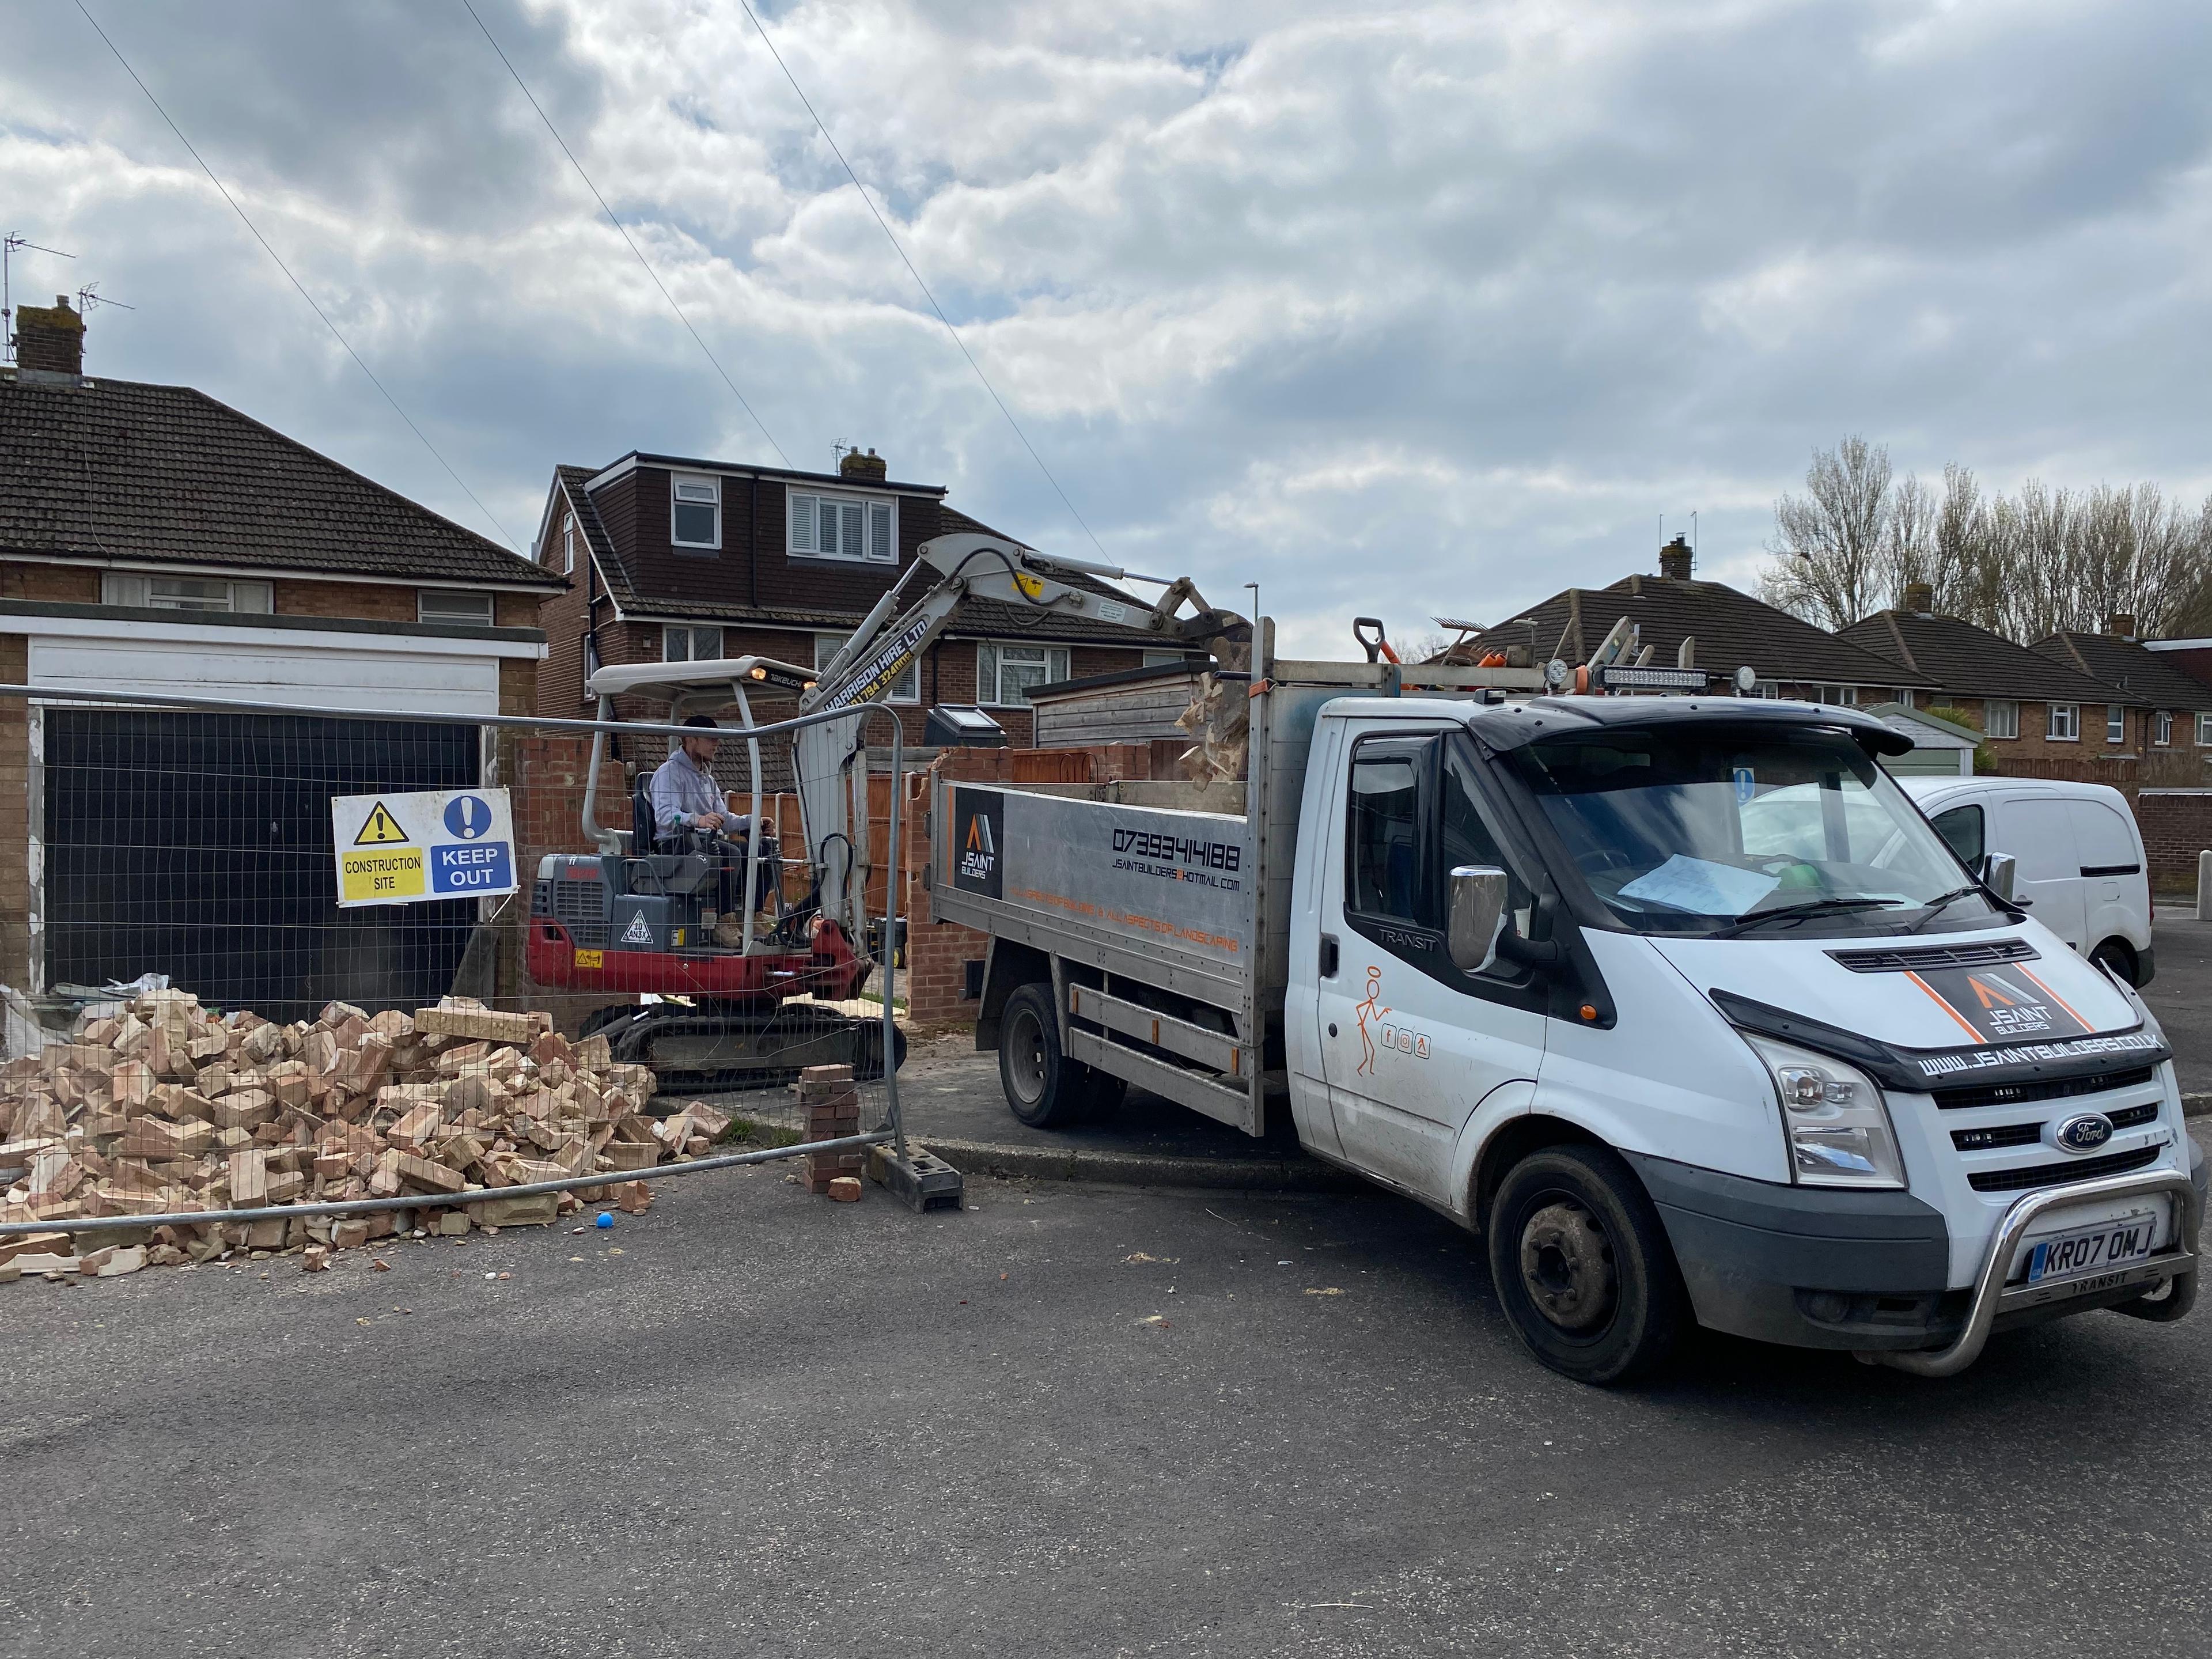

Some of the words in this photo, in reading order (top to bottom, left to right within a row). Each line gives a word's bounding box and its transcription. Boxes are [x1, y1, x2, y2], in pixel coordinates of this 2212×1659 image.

[825, 662, 880, 711] HARRISON
[878, 639, 906, 669] HIRE
[904, 620, 927, 646] LTD
[850, 681, 881, 706] 01794
[442, 848, 498, 866] KEEP
[1112, 828, 1241, 872] 07393414188
[345, 857, 421, 874] CONSTRUCTION
[961, 851, 995, 872] JSAINT
[374, 876, 395, 890] SITE
[450, 869, 494, 886] OUT
[961, 866, 986, 880] BUILDERS
[1379, 929, 1436, 951] TRANSIT
[1989, 1005, 2054, 1027] JSAINT
[1994, 1021, 2051, 1036] BUILDERS
[2076, 1122, 2105, 1143] Ford
[2044, 1234, 2105, 1274] KR07
[2108, 1225, 2153, 1260] OMJ
[2032, 1268, 2041, 1277] GB
[2073, 1272, 2128, 1294] TRANSIT
